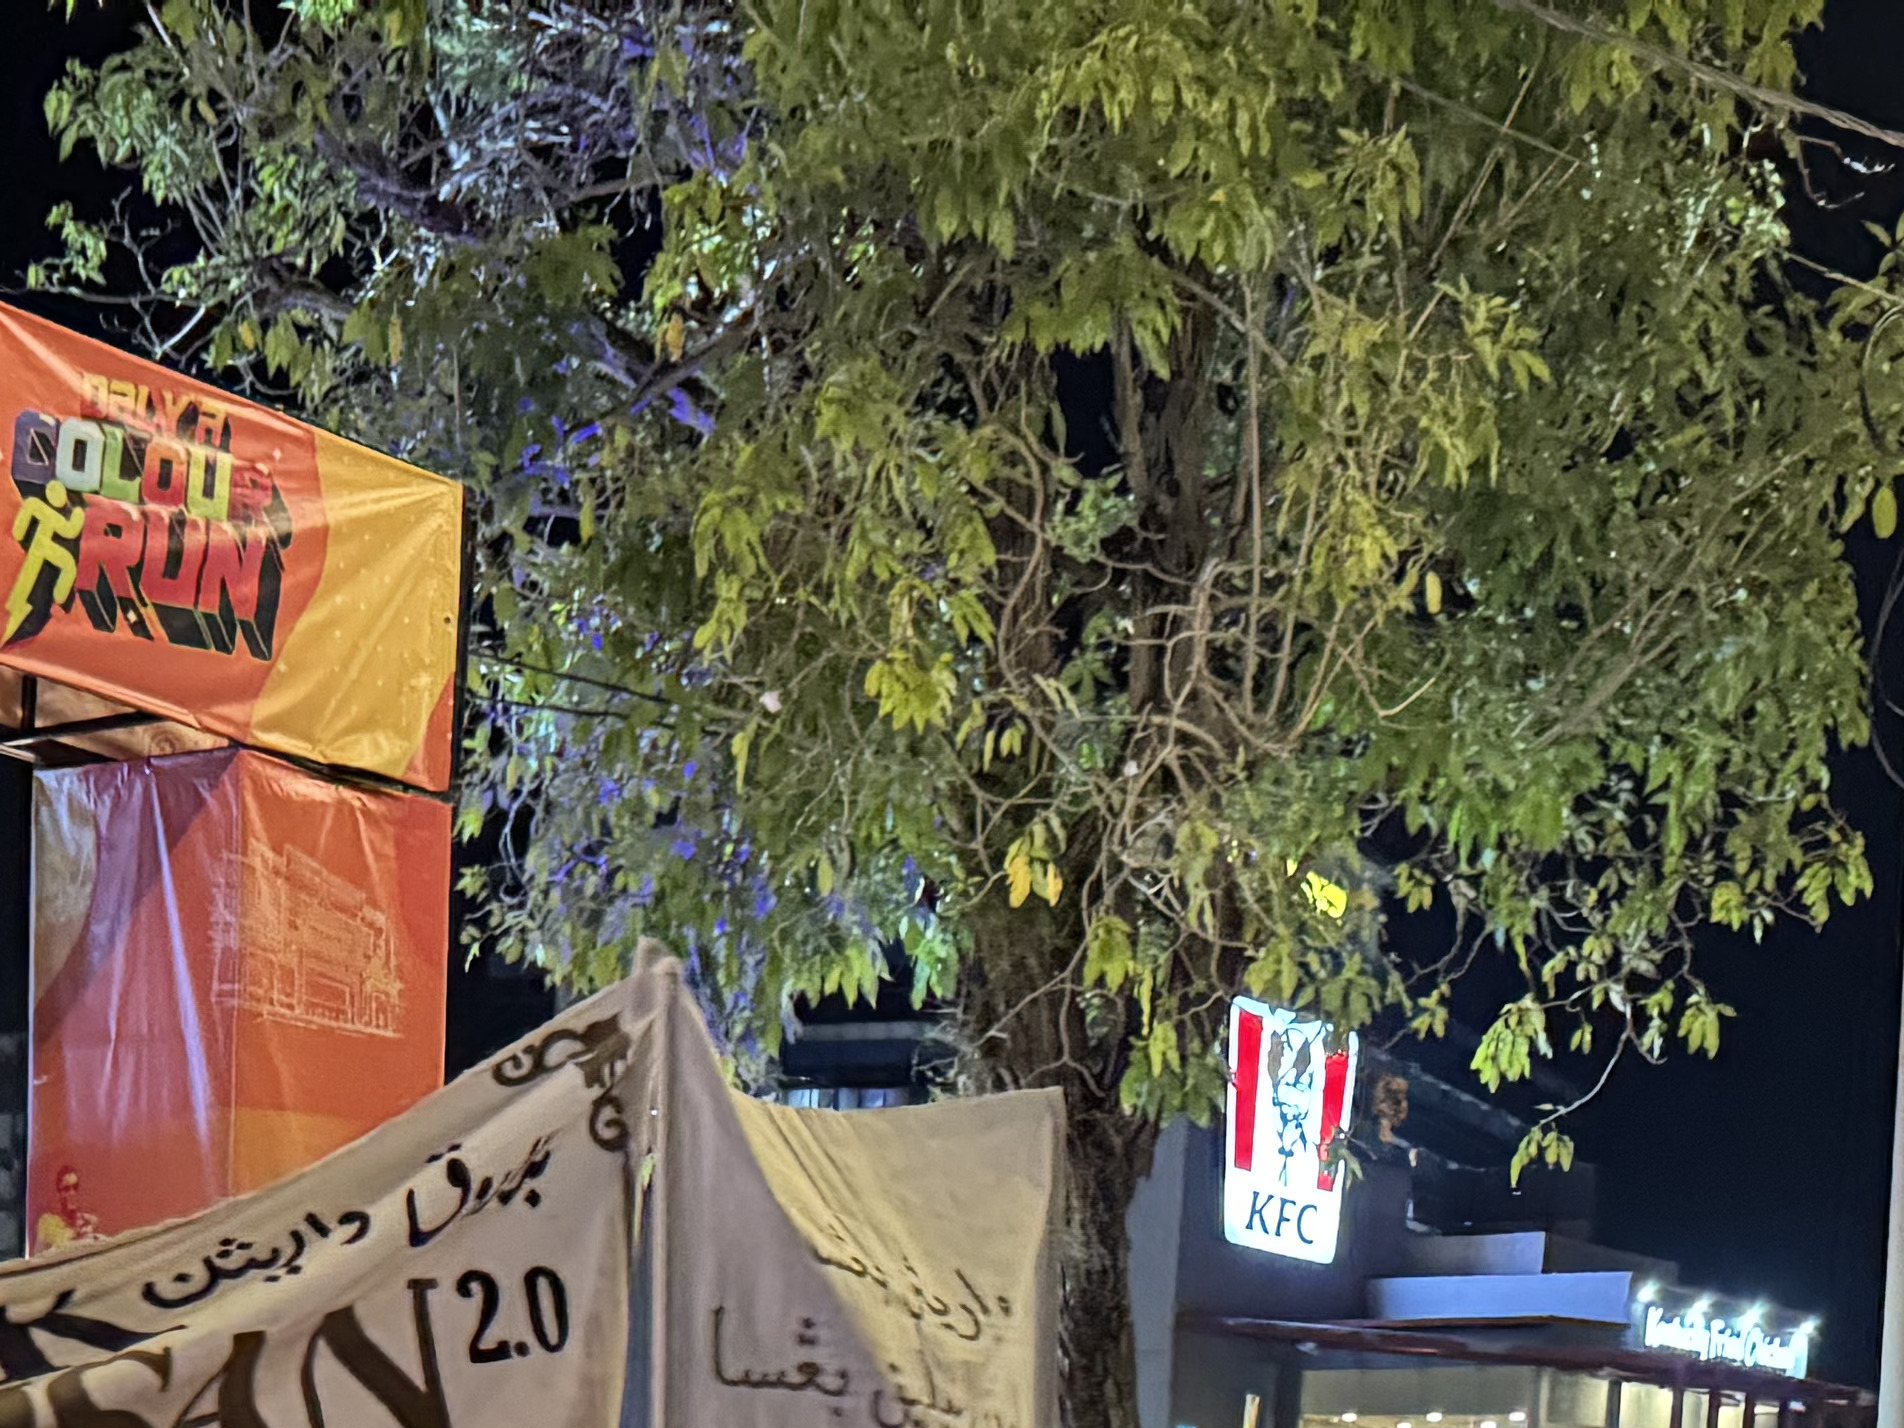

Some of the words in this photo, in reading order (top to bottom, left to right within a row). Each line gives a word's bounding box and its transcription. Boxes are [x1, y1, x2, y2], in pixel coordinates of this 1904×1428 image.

[11, 408, 276, 525] COLOUR
[75, 494, 272, 628] RUN
[1246, 1190, 1319, 1246] KFC
[457, 1264, 570, 1365] 2.0
